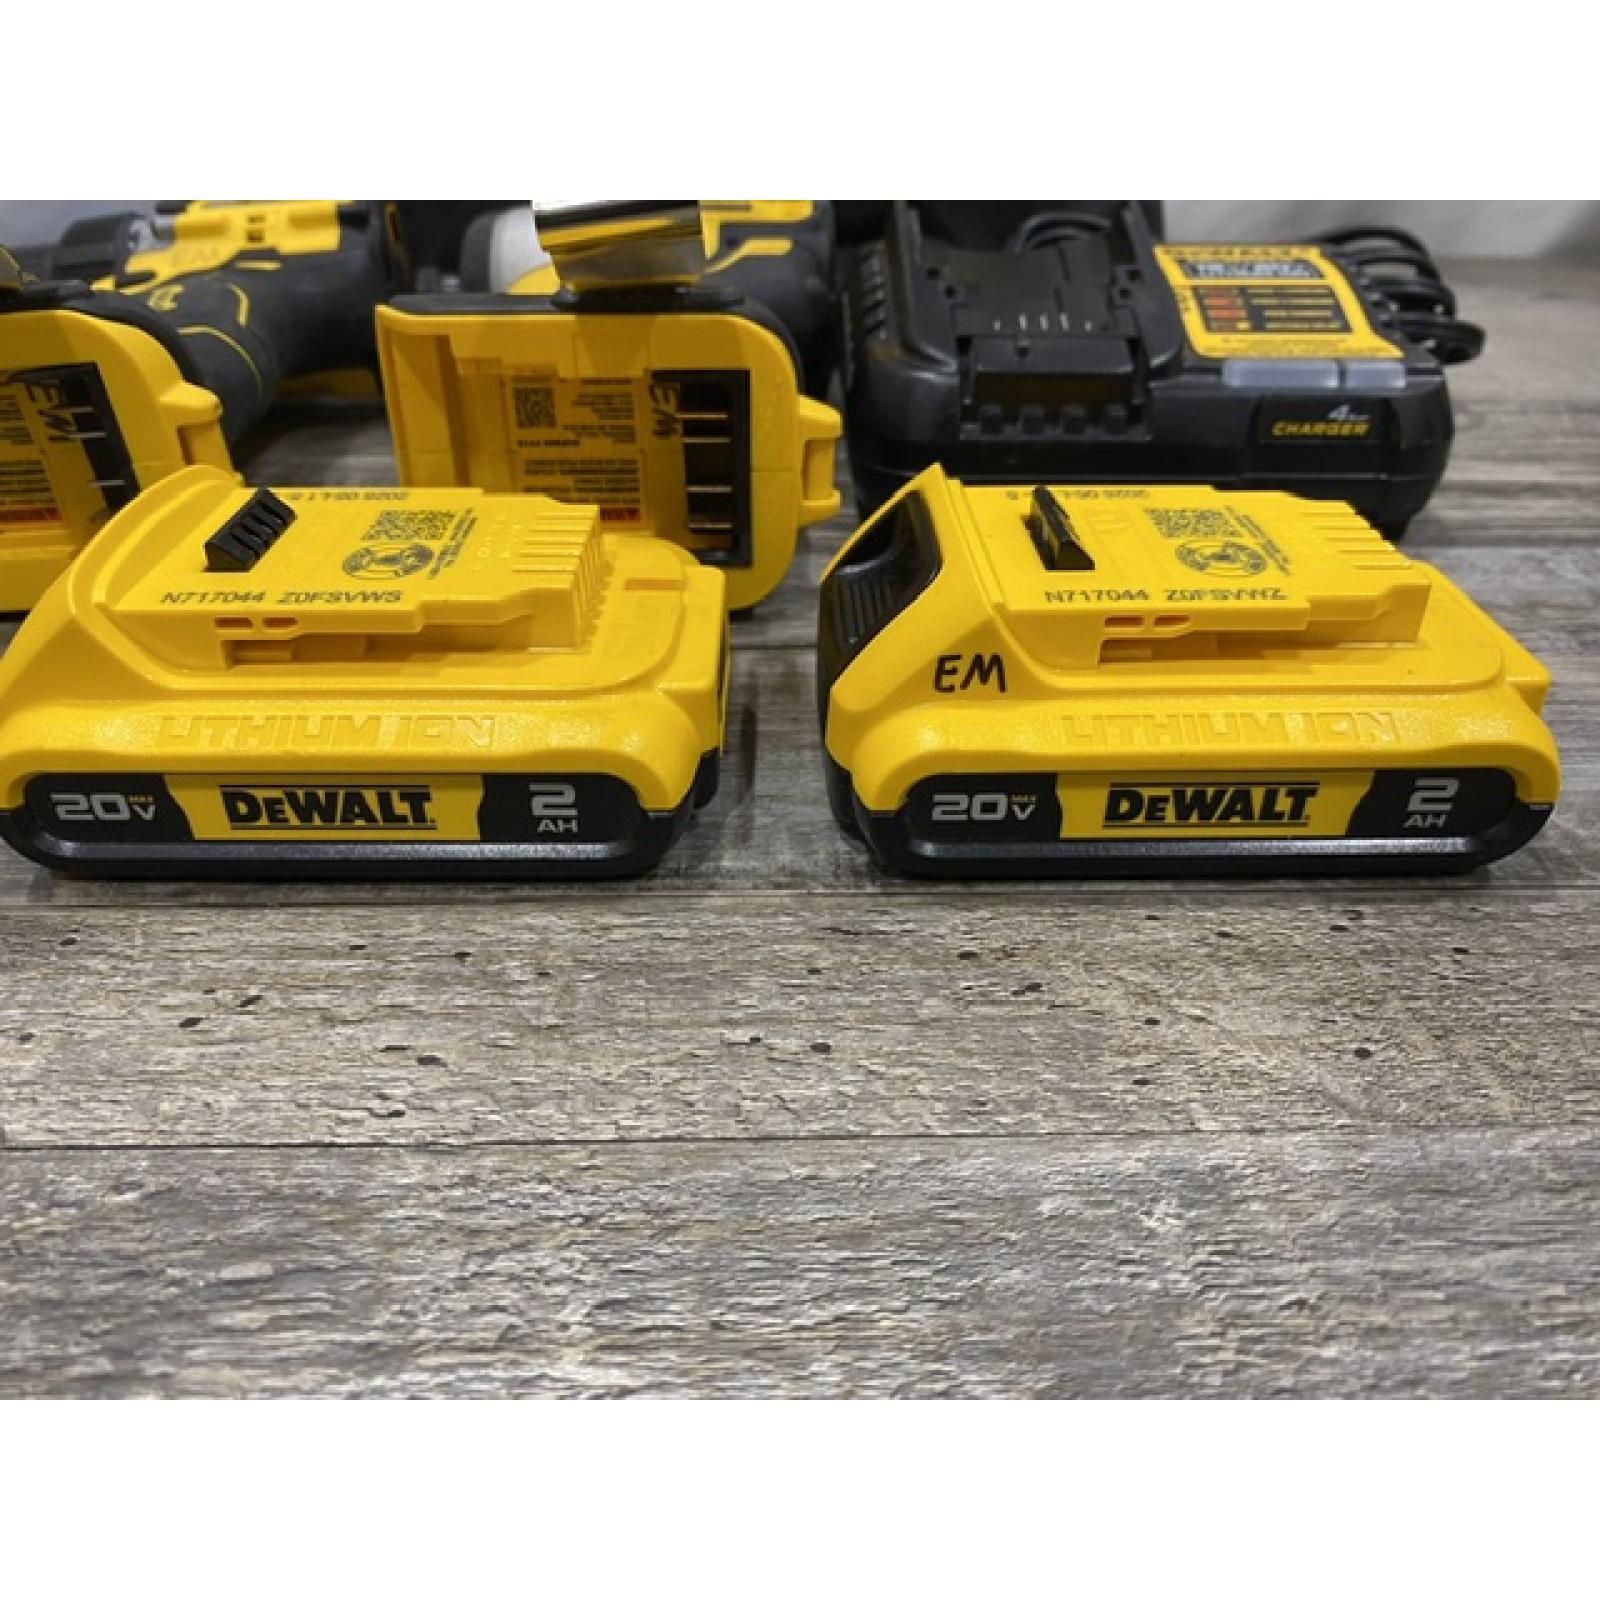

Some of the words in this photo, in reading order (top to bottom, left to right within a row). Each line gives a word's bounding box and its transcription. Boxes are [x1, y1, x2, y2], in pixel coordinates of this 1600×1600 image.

[1272, 420, 1370, 436] CHARGER
[933, 654, 1007, 693] EM
[154, 714, 384, 749] LITHIUM
[396, 714, 496, 749] ION
[1060, 712, 1290, 747] LITHIUM
[1298, 712, 1400, 746] ION
[530, 784, 578, 816] 2
[1407, 778, 1459, 811] 2
[537, 819, 578, 833] AH
[1403, 814, 1447, 828] AH
